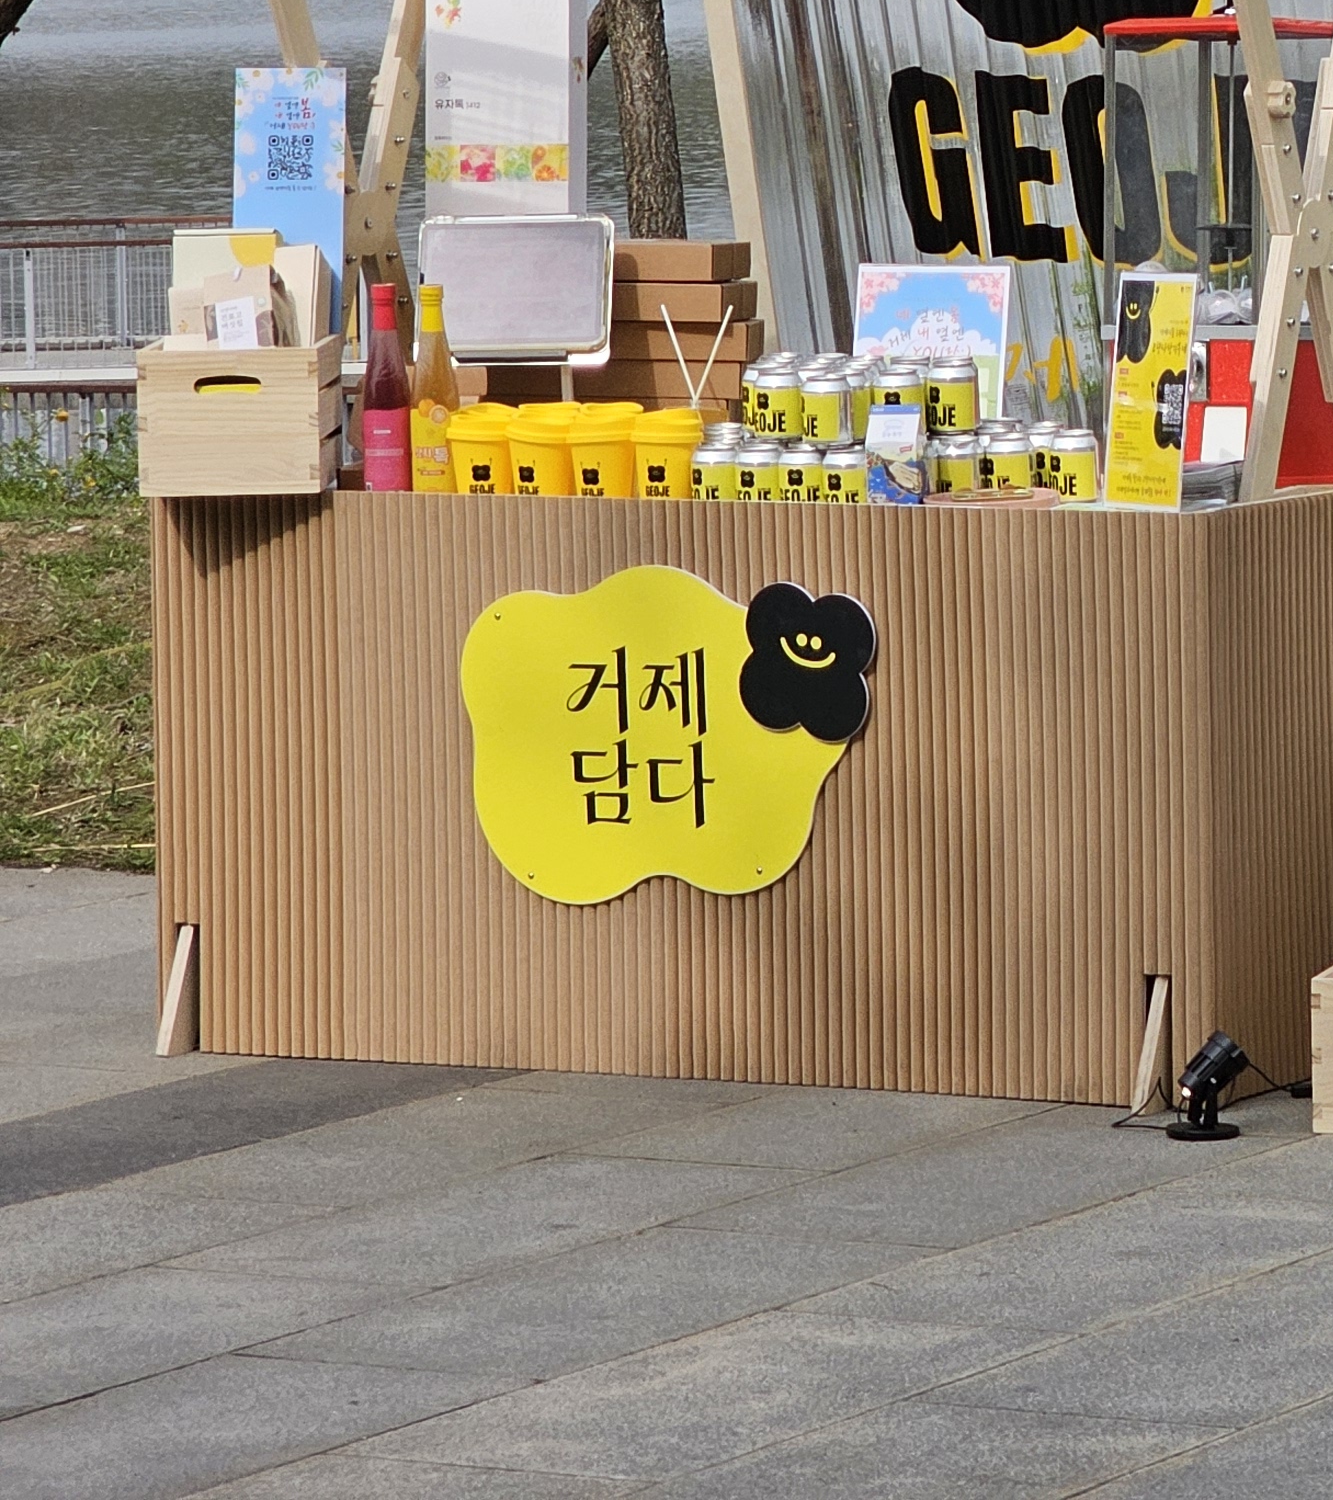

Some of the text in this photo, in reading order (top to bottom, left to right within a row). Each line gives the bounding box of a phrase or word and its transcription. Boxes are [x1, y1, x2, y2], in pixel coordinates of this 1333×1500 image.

[645, 485, 670, 498] GEOJE
[567, 646, 707, 737] 거제
[570, 739, 715, 829] 담다
